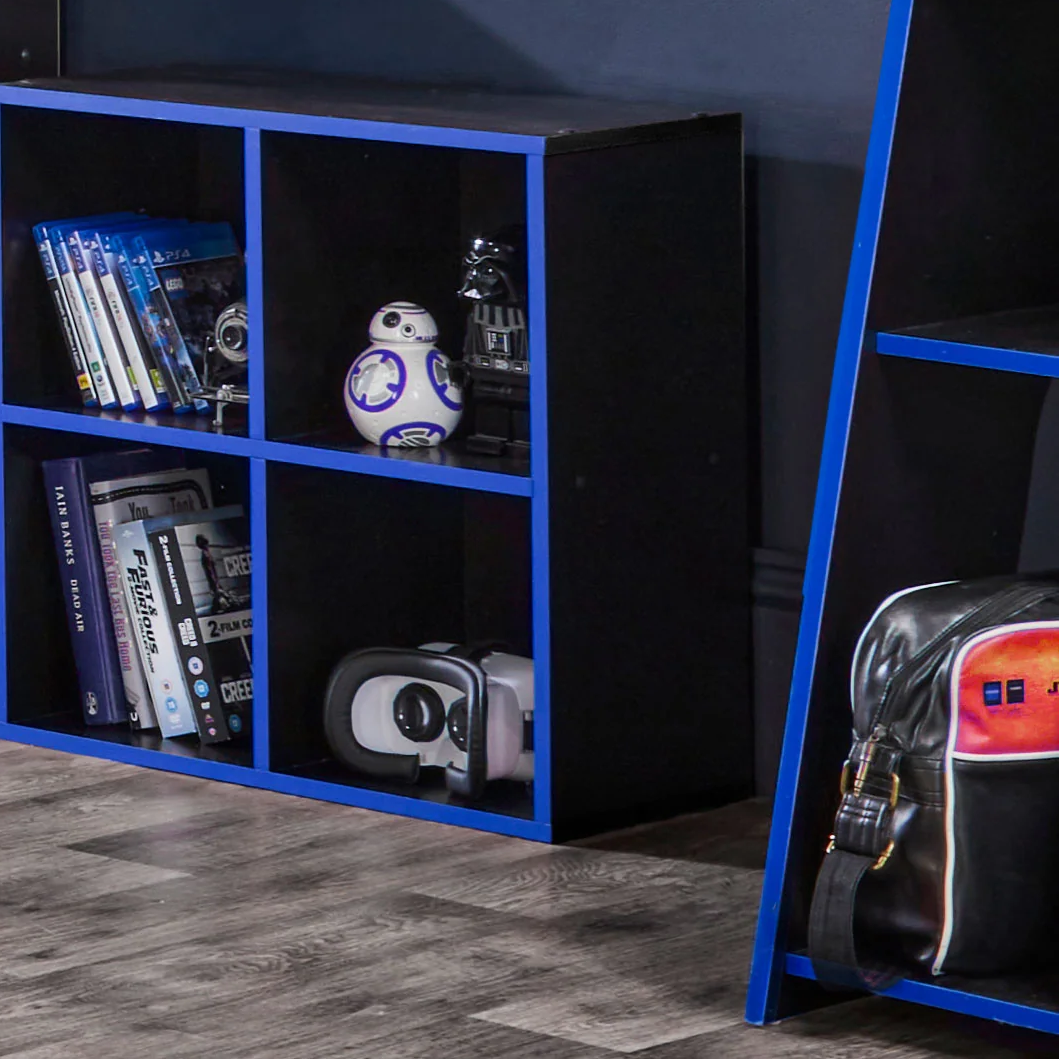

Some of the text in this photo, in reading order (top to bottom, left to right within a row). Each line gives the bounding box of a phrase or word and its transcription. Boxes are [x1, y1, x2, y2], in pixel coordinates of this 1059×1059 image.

[165, 249, 192, 261] PS4
[165, 277, 184, 291] LEGO
[128, 501, 150, 520] You
[54, 485, 85, 633] IAIN BANKS DEAD AIR
[133, 548, 158, 617] FAST &
[126, 567, 160, 655] FURIOUS
[207, 620, 241, 639] 2-FILM
